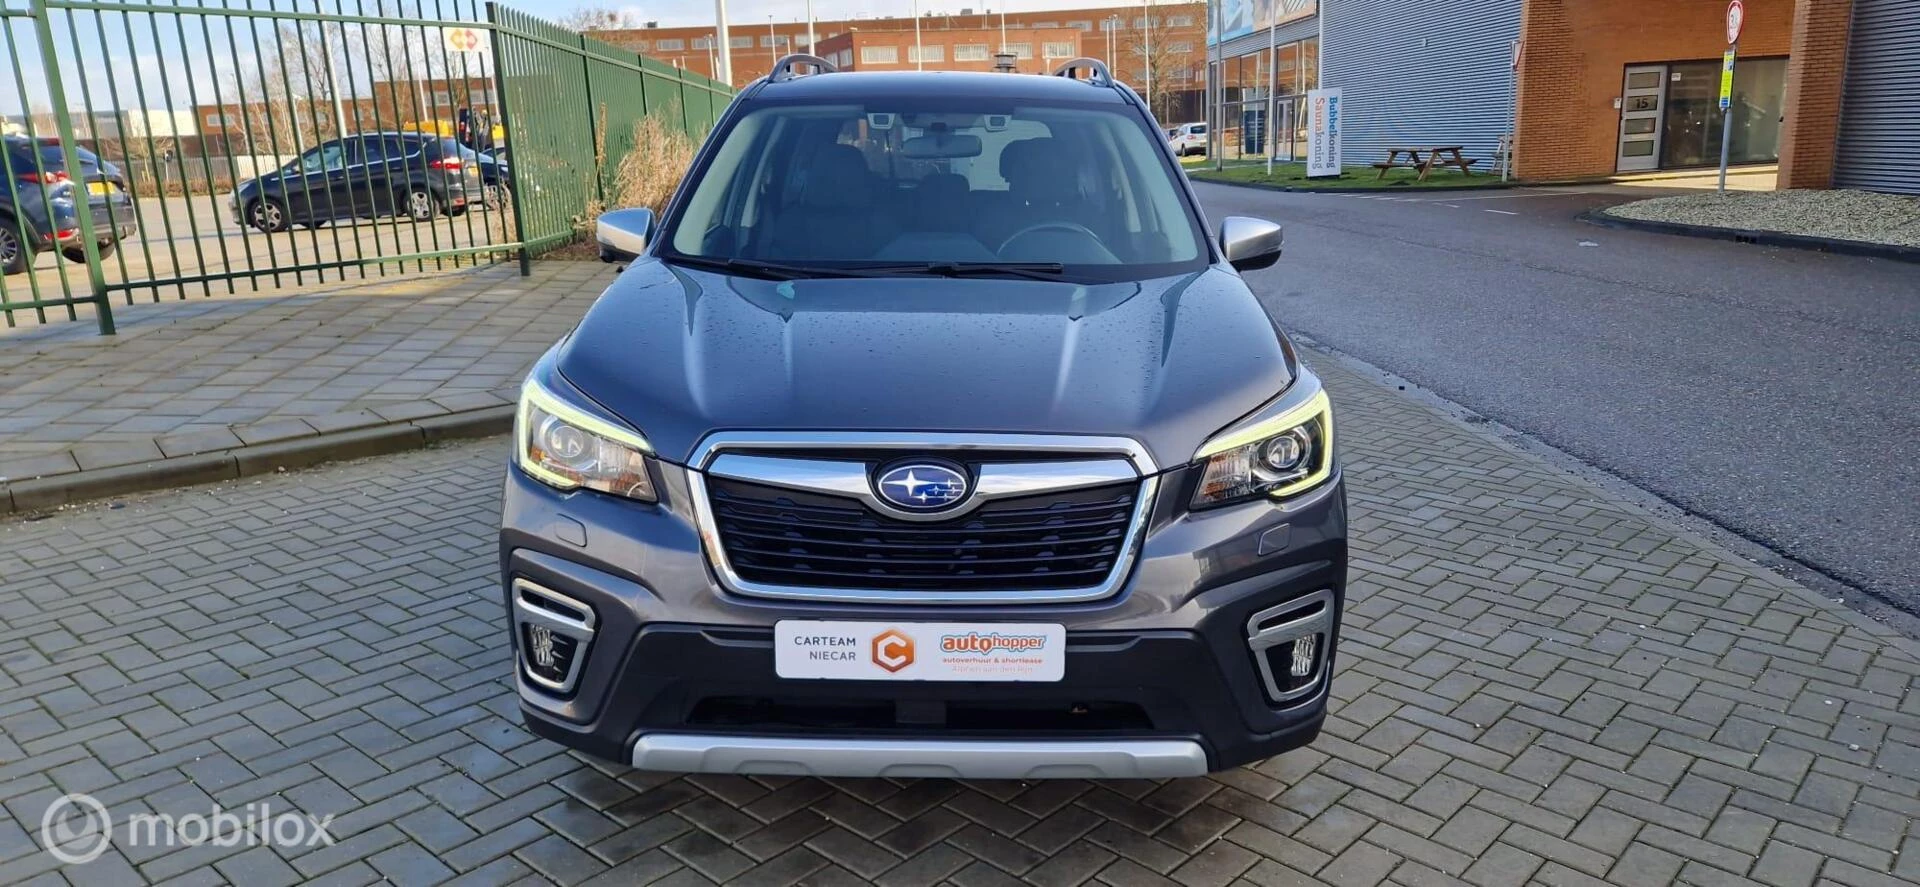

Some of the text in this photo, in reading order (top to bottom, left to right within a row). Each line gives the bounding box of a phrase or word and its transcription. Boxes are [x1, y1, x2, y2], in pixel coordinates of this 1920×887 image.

[1636, 98, 1649, 109] 15
[1312, 97, 1325, 170] Saunakoning
[1326, 96, 1338, 169] Bubbelkoning
[794, 636, 856, 646] CARTEAM
[942, 633, 1045, 652] autohopper
[809, 651, 856, 661] NIECAR
